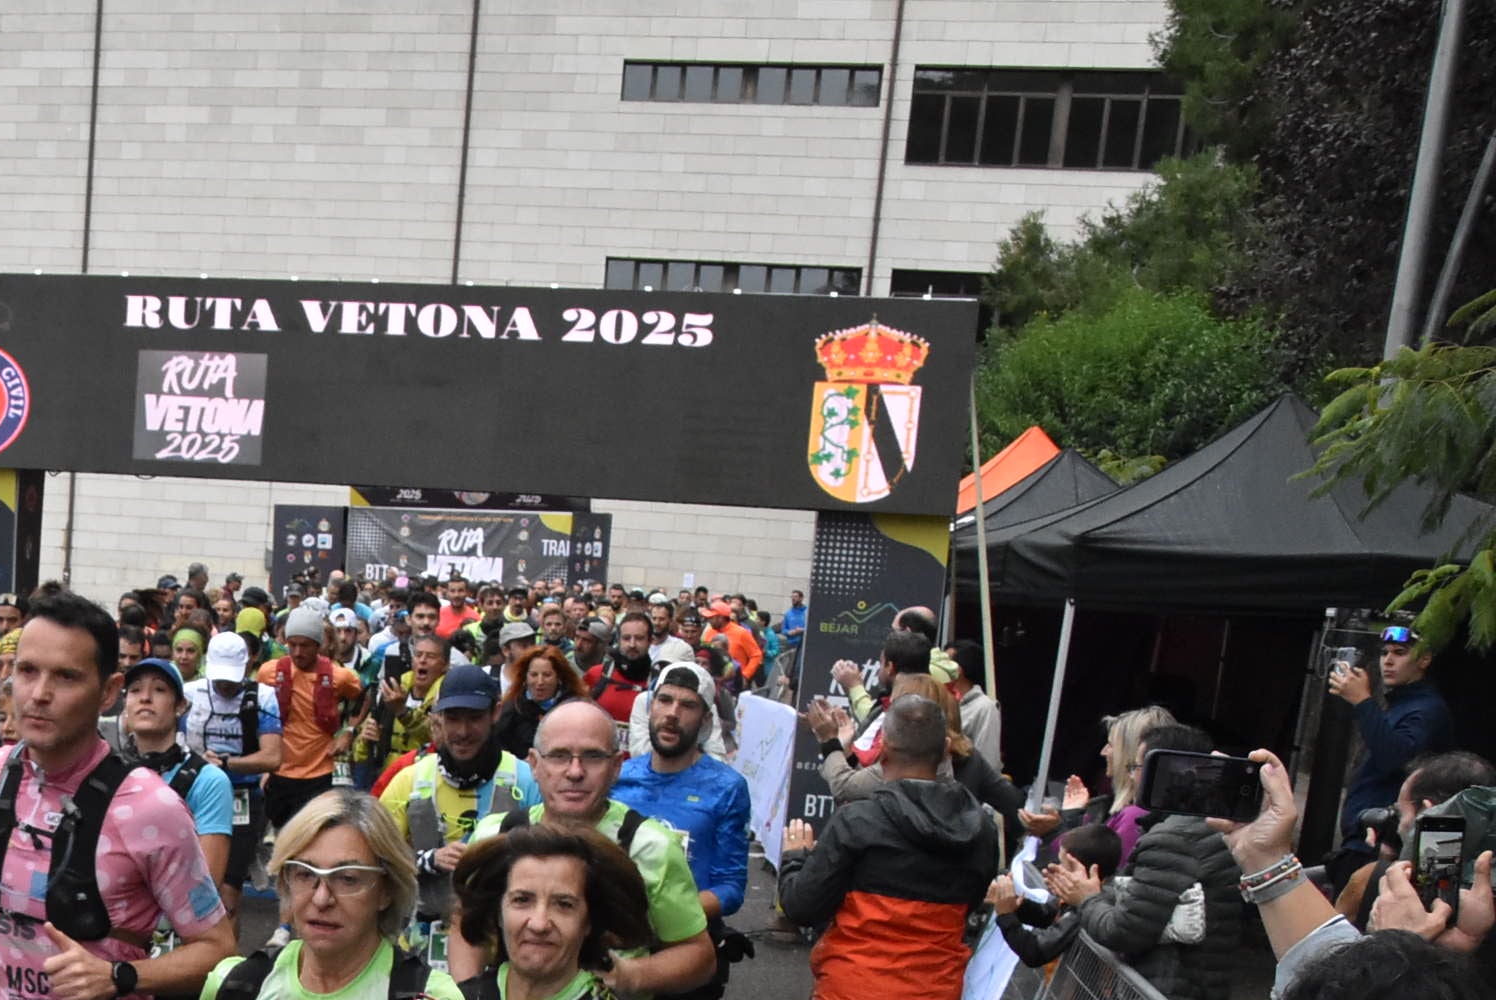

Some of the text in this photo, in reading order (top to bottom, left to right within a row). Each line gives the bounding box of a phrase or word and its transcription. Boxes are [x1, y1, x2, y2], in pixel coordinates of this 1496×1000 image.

[124, 295, 715, 348] RUTA VETONA 2025
[1, 367, 24, 418] CIVIL
[161, 353, 237, 398] RUTA
[144, 394, 265, 436] VETONA
[155, 432, 240, 463] 2025
[438, 527, 485, 557] RUTA
[541, 538, 571, 557] TRAI
[365, 562, 389, 580] BTT
